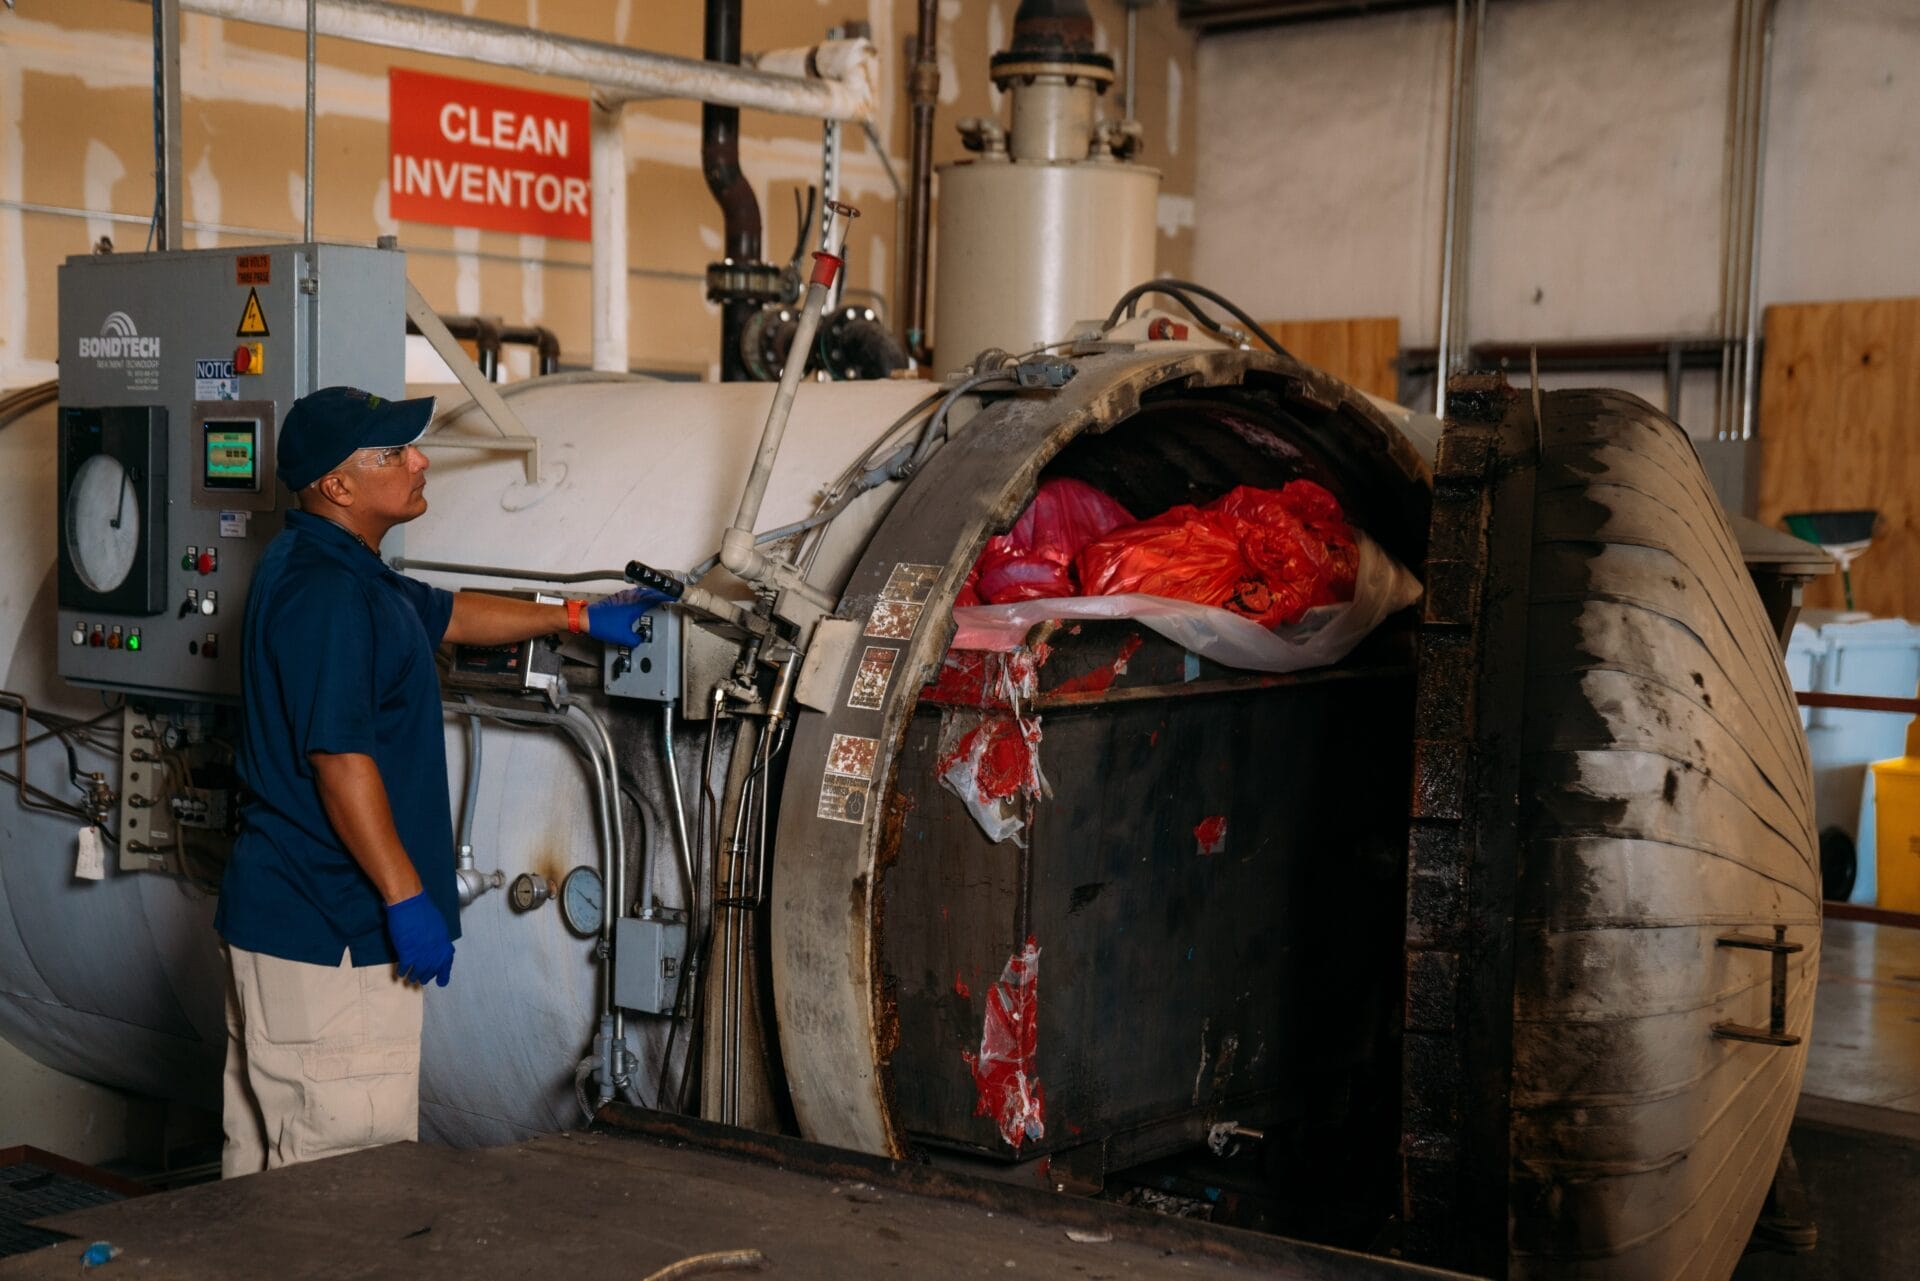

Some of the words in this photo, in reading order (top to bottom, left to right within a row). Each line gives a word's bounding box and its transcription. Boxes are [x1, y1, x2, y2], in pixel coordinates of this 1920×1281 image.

[440, 102, 568, 157] CLEAN
[393, 154, 592, 216] INVENTOR
[79, 336, 160, 358] BONDTECH
